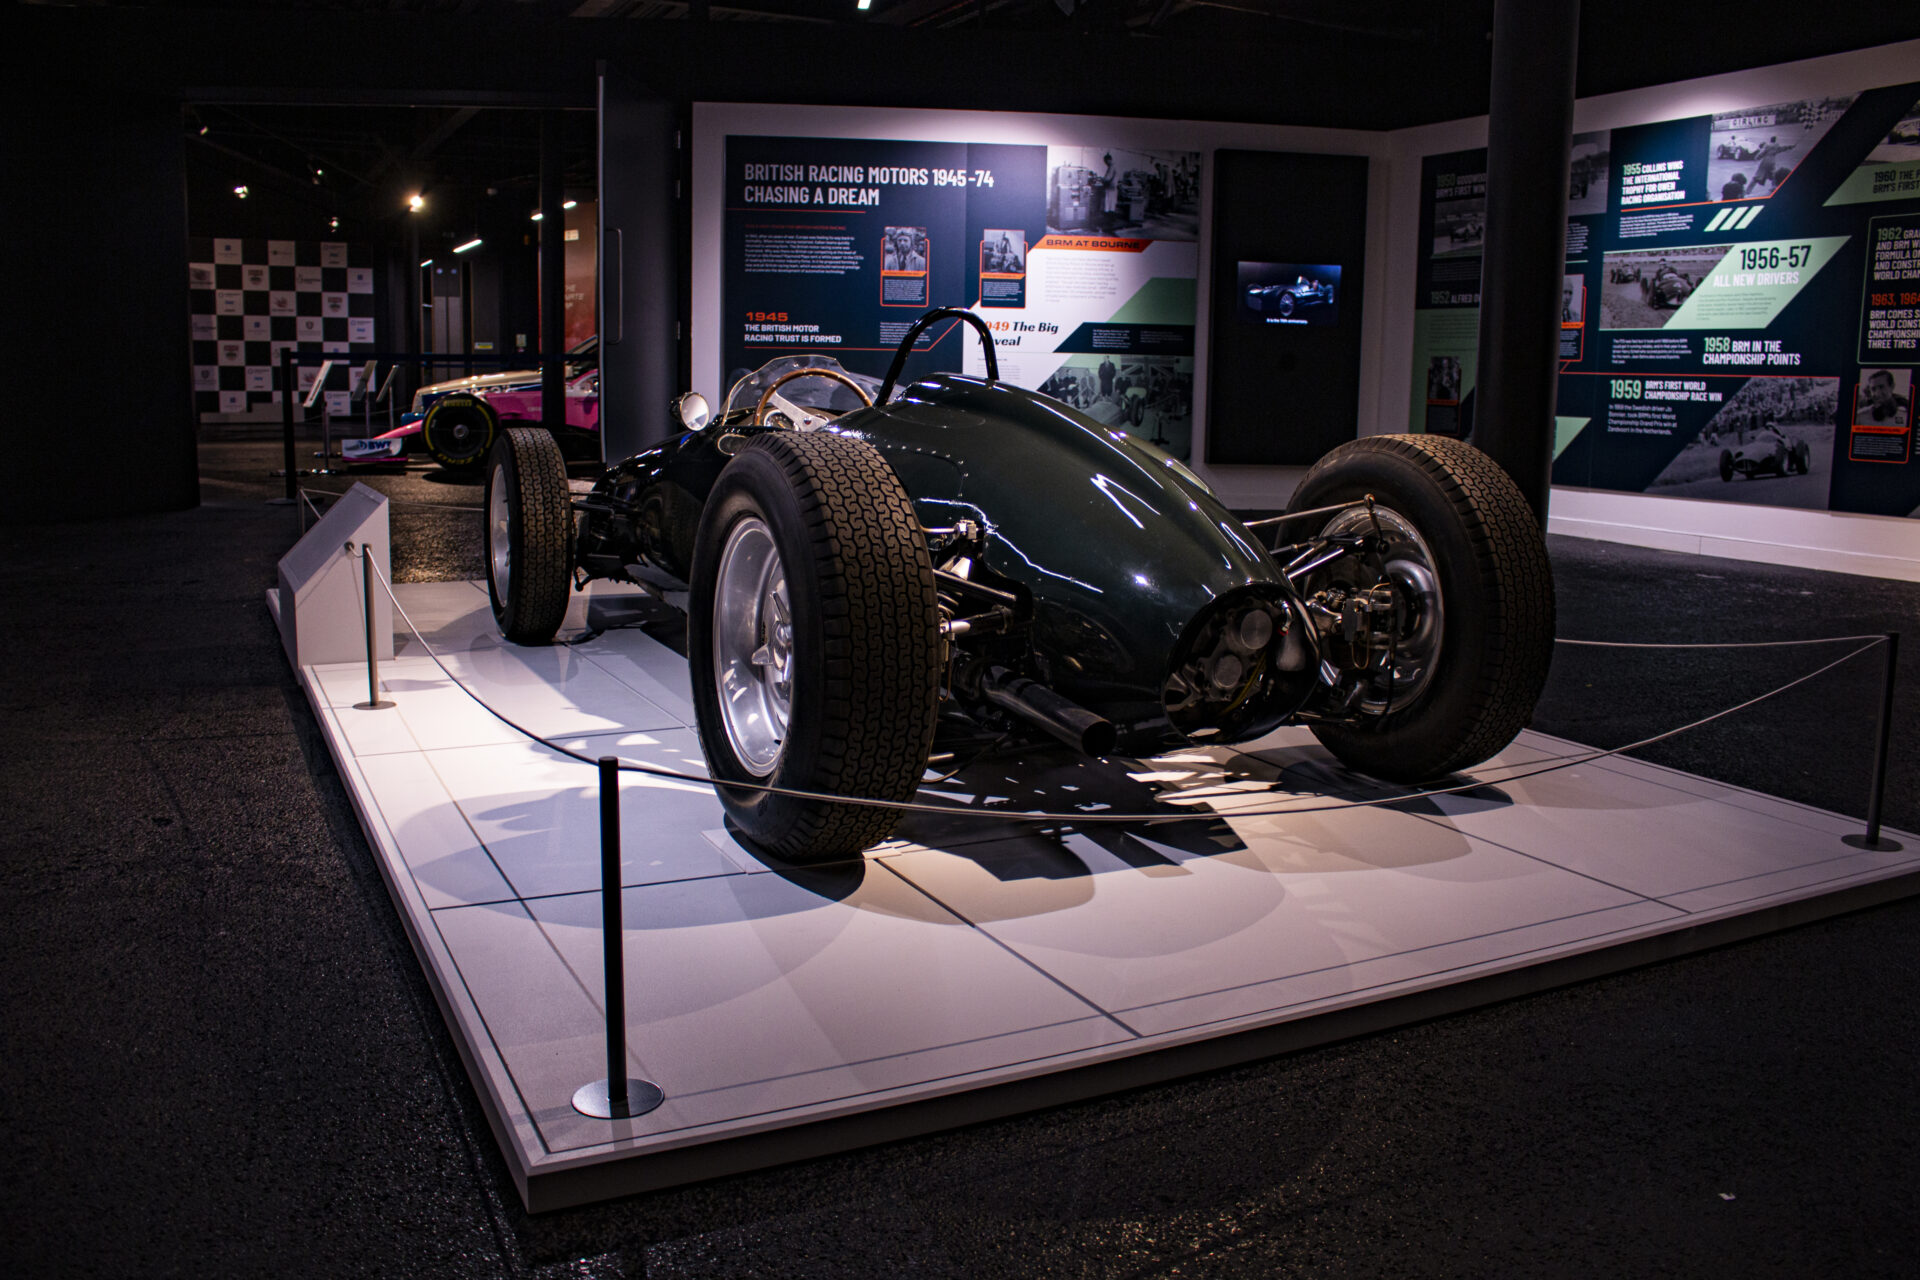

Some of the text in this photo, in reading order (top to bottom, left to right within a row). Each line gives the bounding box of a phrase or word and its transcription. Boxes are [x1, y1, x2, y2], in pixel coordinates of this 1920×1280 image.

[1623, 163, 1642, 176] 1955
[1666, 160, 1684, 171] WINS
[744, 163, 995, 188] BRITISH RACING MOTORS 1945-74
[1622, 170, 1680, 186] THE INTERNATIONAL
[1874, 169, 1897, 184] 1960
[744, 185, 880, 206] CHASING A DREAM
[1622, 184, 1645, 196] TROPHY
[1645, 183, 1657, 193] FOR
[1621, 195, 1643, 205] RACING
[1877, 227, 1903, 241] 1962
[1091, 240, 1140, 249] BOURNE
[1875, 240, 1893, 251] AND
[1893, 239, 1911, 250] BRM
[1741, 244, 1812, 270] 1956-57
[1875, 249, 1912, 261] FORMULA
[1874, 260, 1891, 271] AND
[1713, 271, 1800, 287] ALL NEW DRIVERS
[1873, 270, 1901, 281] WORLD
[745, 311, 789, 322] 1945
[1869, 309, 1886, 320] BRM
[1887, 308, 1914, 319] COMES
[744, 323, 820, 333] THE BRITISH MOTOR
[1012, 321, 1036, 332] The
[1037, 322, 1060, 335] Big
[1869, 319, 1897, 330] WORLD
[744, 333, 842, 344] RACING TRUST IS FORMED
[1868, 329, 1920, 339] CHAMPIONSHI
[1703, 336, 1731, 353] 1958
[1732, 340, 1751, 353] BRM
[1752, 340, 1763, 353] IN
[1764, 340, 1783, 353] THE
[1867, 338, 1917, 349] THREE TIMES
[1702, 353, 1802, 366] CHAMPIONSHIP POINTS
[1609, 379, 1707, 400] 1959 BRM'S FIRST WORLD
[1644, 391, 1724, 403] CHAMPIONSHIP RACE WIN
